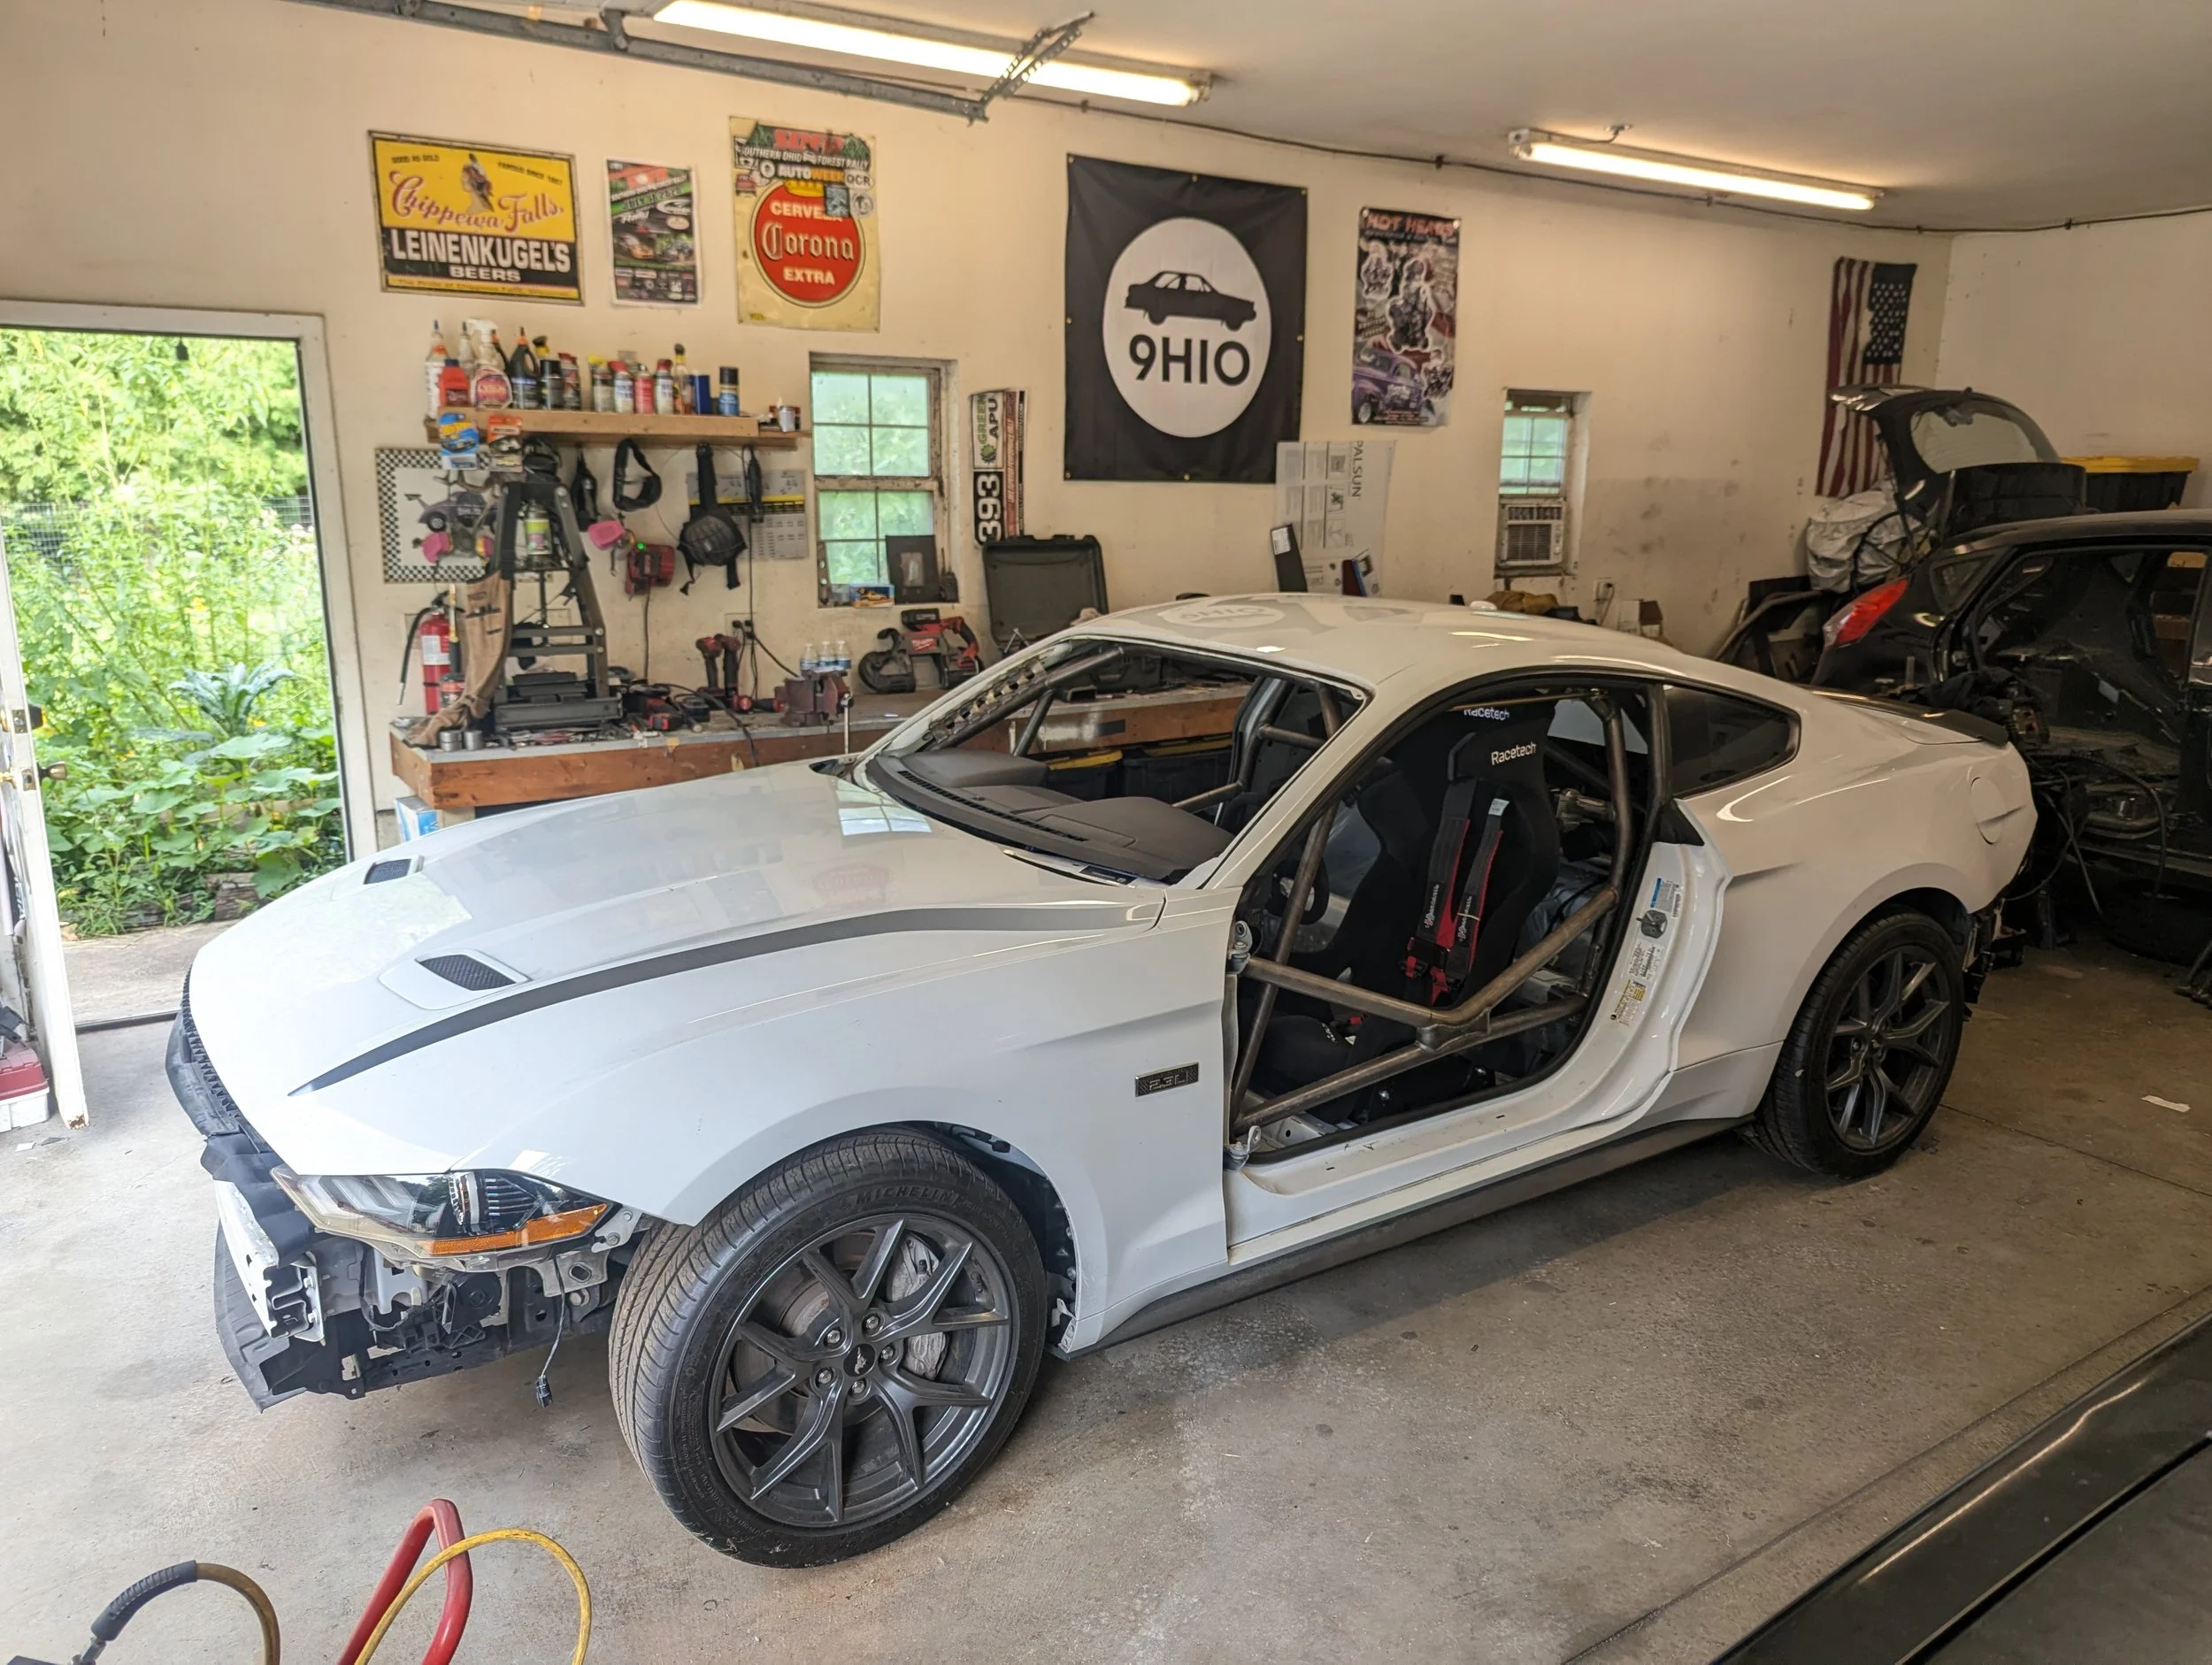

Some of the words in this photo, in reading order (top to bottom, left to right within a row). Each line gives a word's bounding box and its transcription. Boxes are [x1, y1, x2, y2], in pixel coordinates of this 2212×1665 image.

[846, 173, 871, 187] OCR
[388, 170, 501, 230] Chippewa
[770, 199, 843, 223] CERVE
[761, 220, 855, 261] Corona
[449, 265, 522, 283] BEERS
[782, 266, 835, 285] EXTRA
[1129, 334, 1251, 387] 9HIO
[988, 398, 999, 440] APU
[1351, 441, 1363, 497] PALSUN
[977, 474, 1002, 542] 393
[1491, 740, 1538, 767] Racetech
[856, 1185, 956, 1206] MICHELIN
